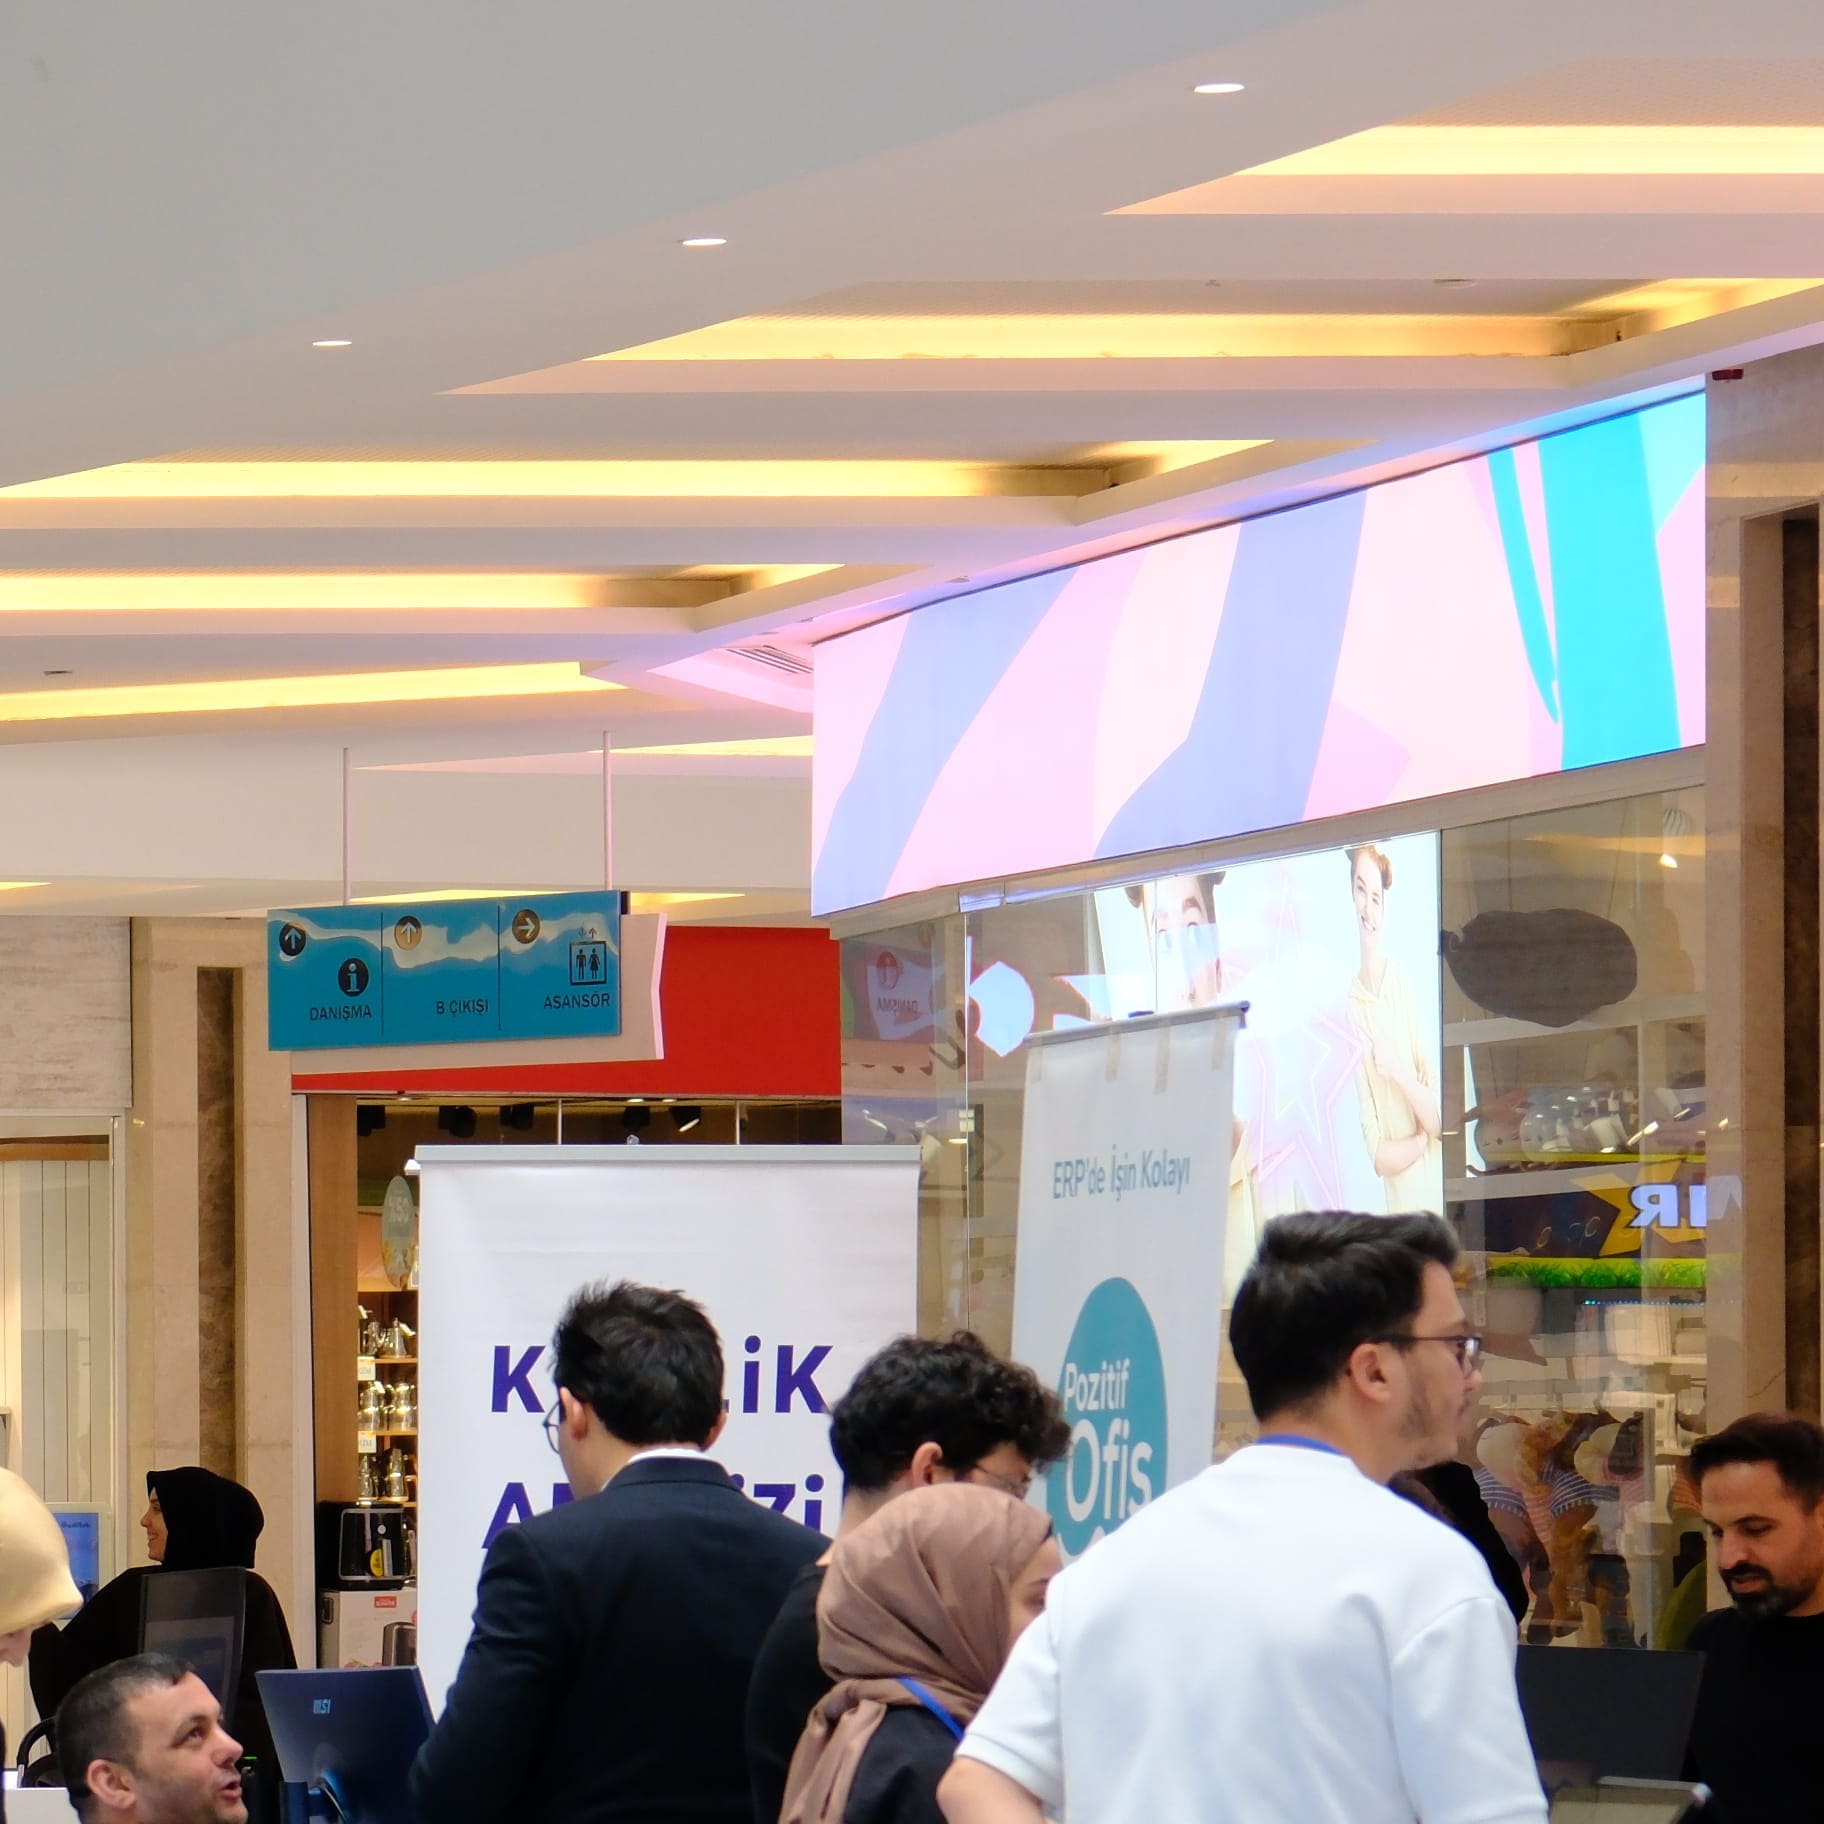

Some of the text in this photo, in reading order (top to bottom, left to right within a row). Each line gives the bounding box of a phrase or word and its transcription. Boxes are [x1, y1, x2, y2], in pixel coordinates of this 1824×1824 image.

[309, 1004, 373, 1022] DANIŞMA
[436, 1000, 445, 1015] B
[543, 992, 611, 1010] ASANSÖR
[1053, 1143, 1192, 1201] ERP'de İşin Kolayı
[1064, 1358, 1131, 1413] Pozitif
[1066, 1418, 1153, 1522] Ofis
